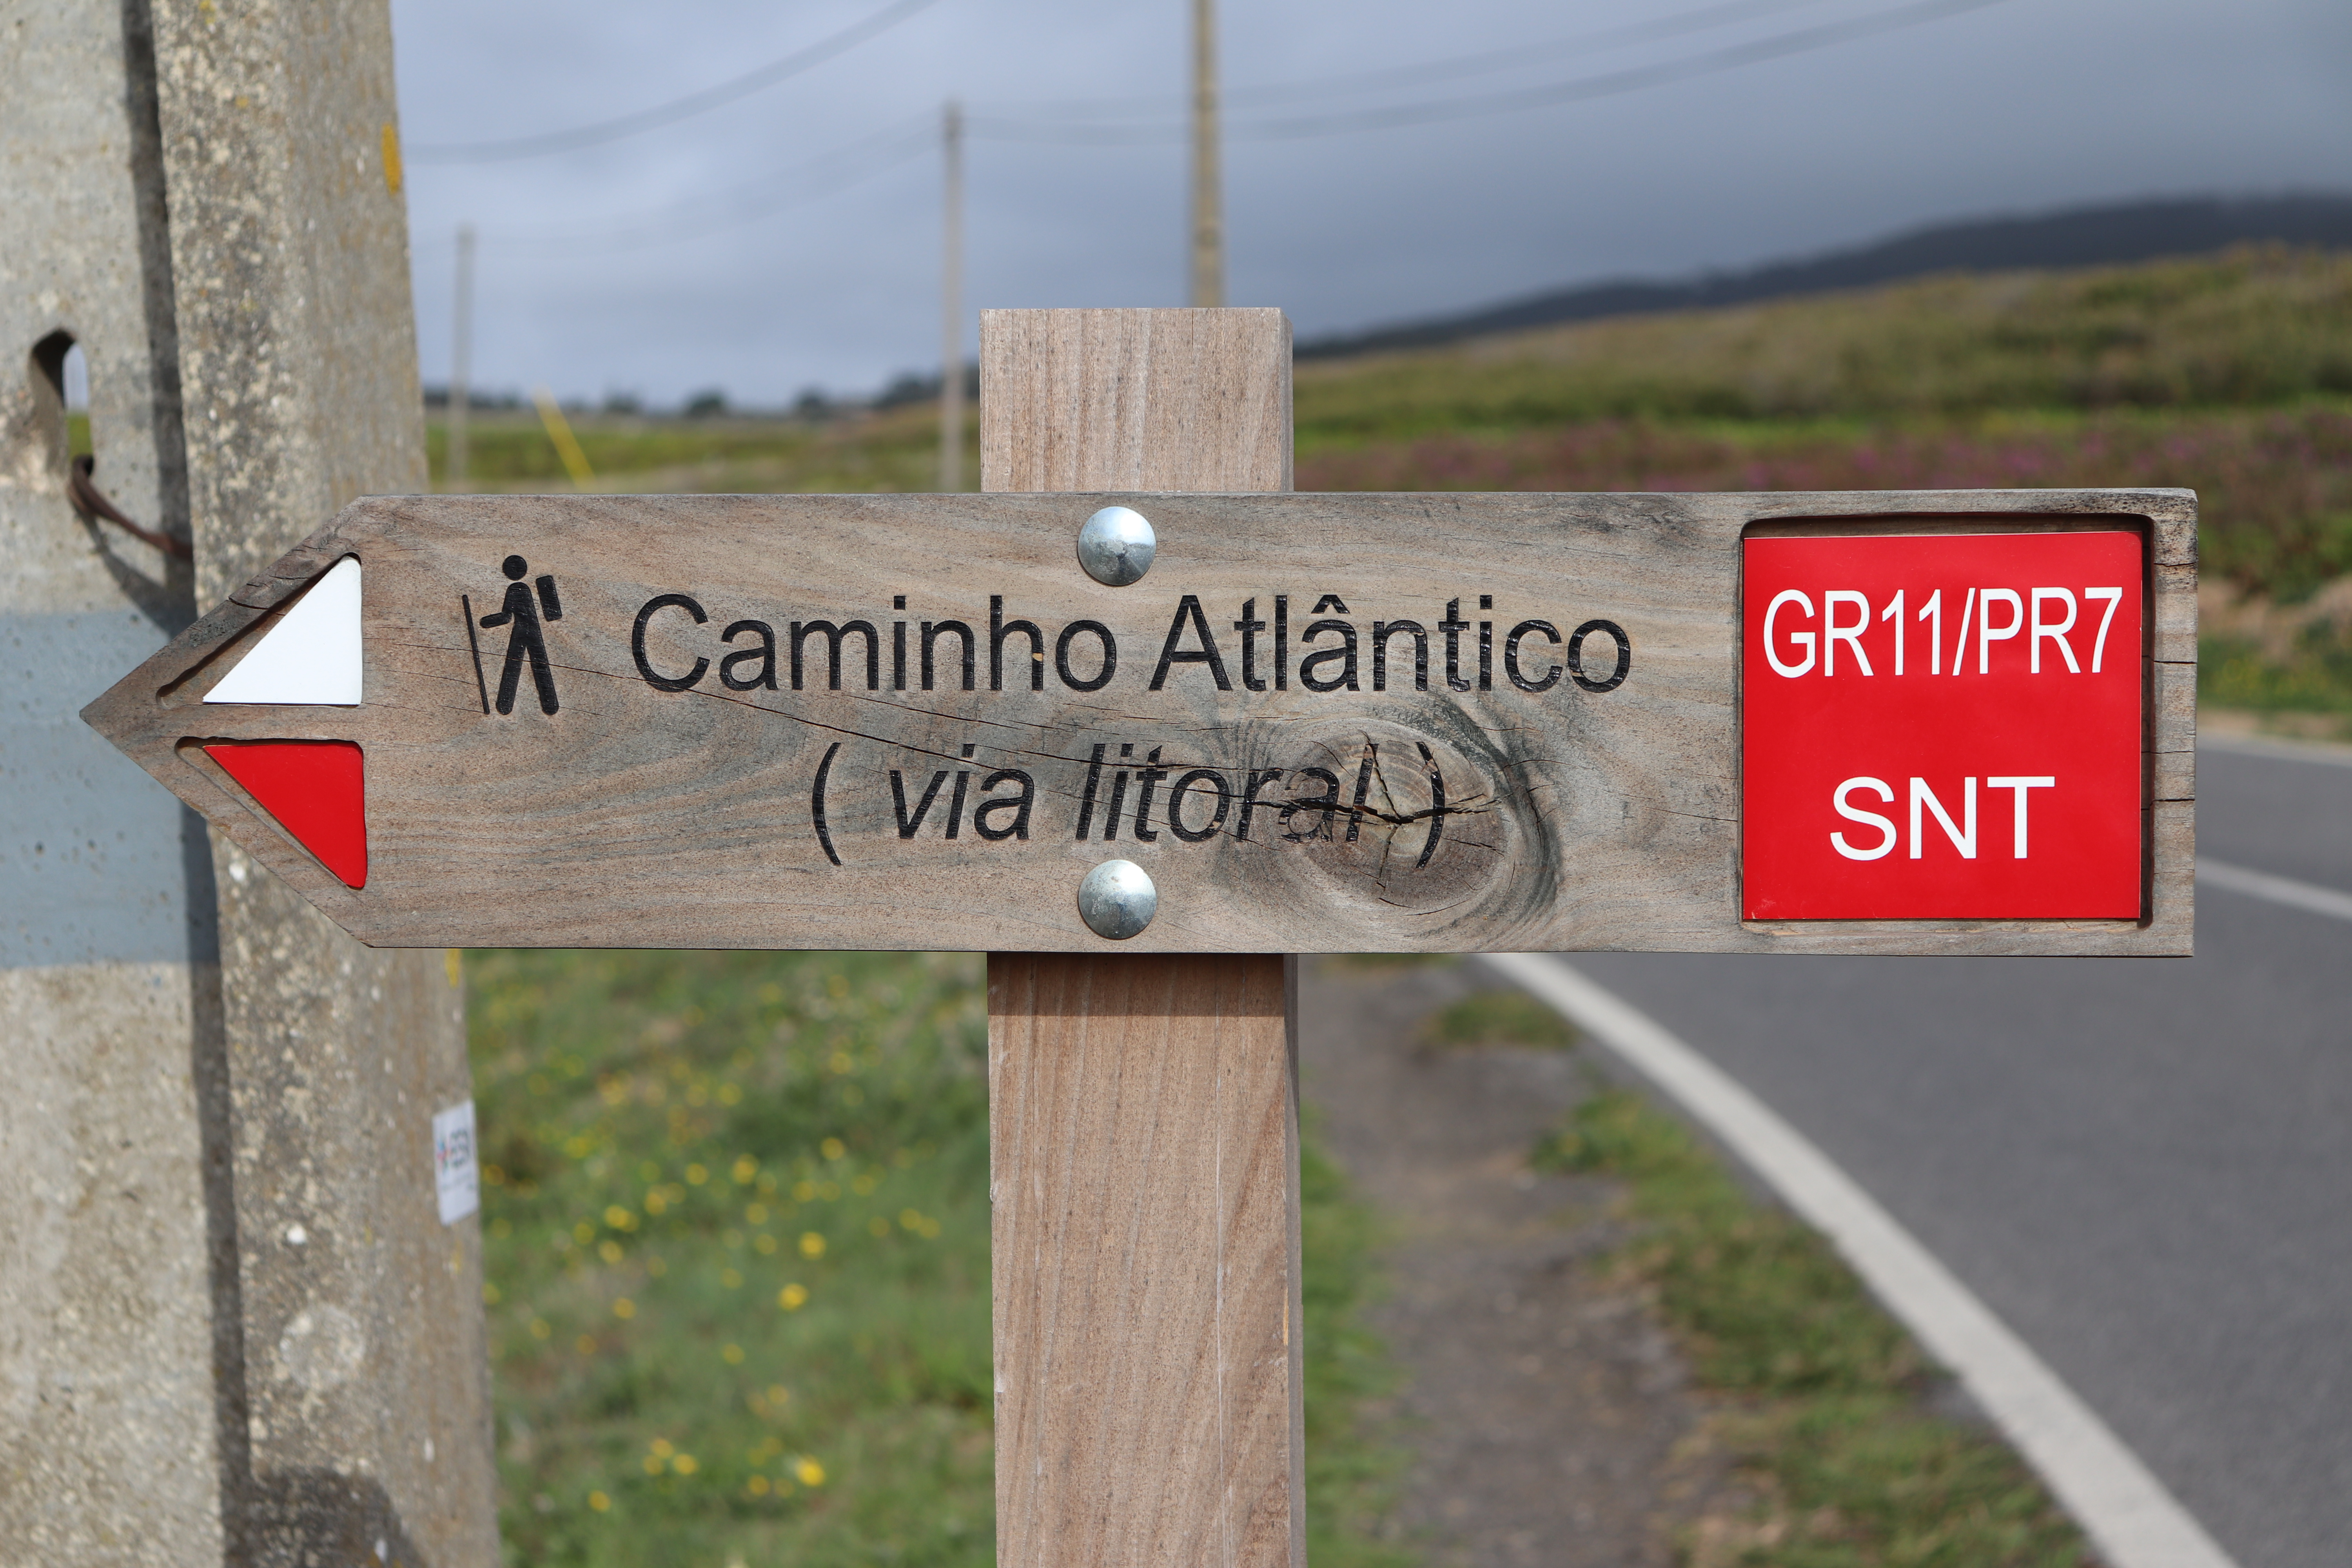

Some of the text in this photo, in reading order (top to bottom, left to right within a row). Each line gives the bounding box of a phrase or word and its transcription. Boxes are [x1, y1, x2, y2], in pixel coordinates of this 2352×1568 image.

[631, 593, 1631, 693] Caminho Atlântico
[1763, 586, 2123, 679] GR11/PR7
[889, 743, 1035, 841] via
[1829, 776, 2055, 861] SNT
